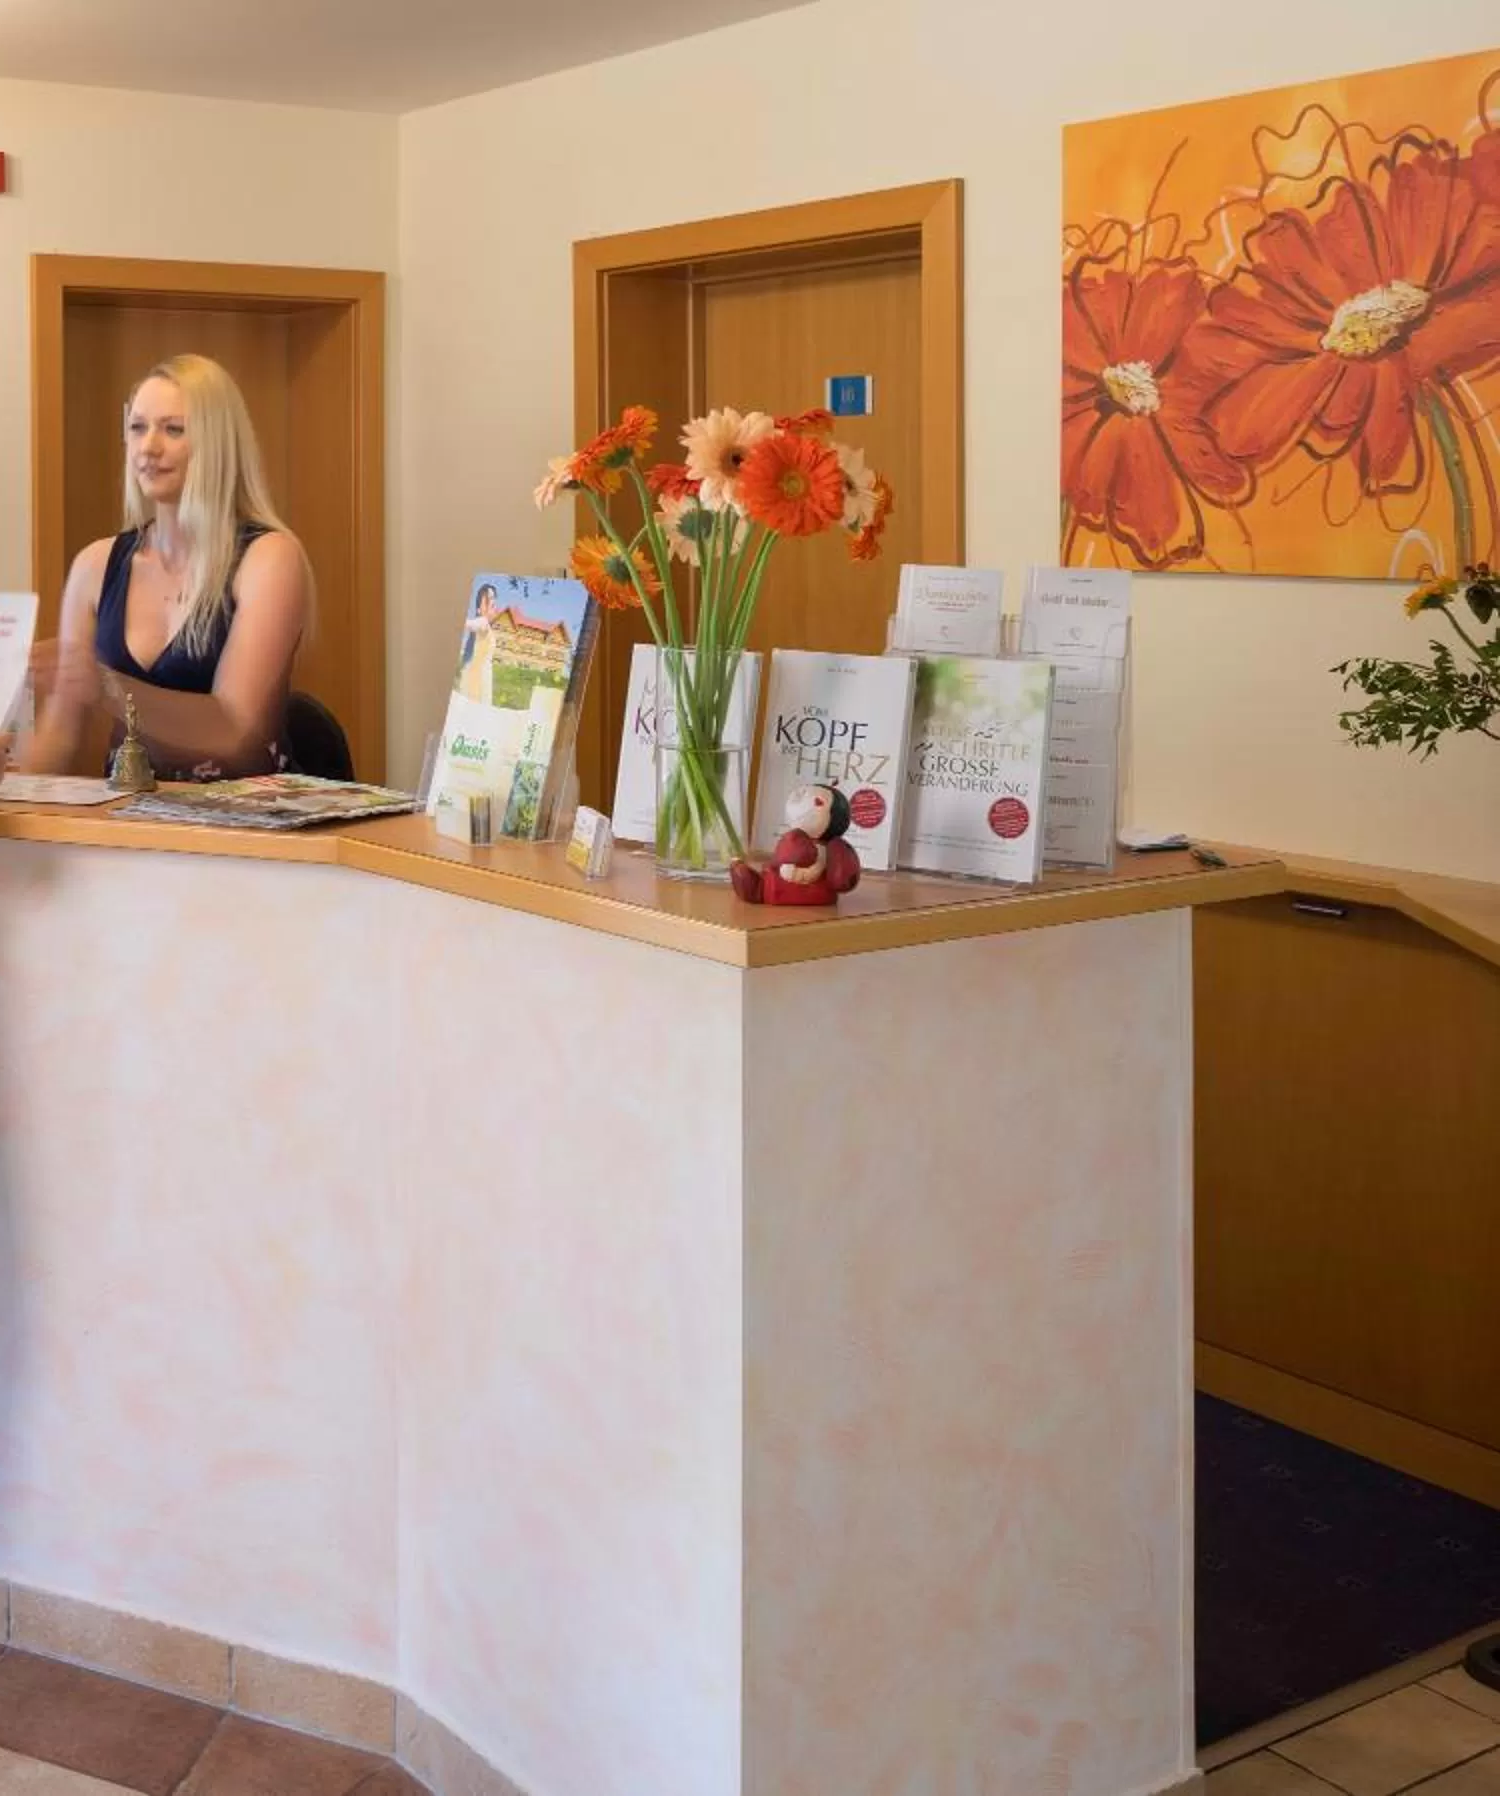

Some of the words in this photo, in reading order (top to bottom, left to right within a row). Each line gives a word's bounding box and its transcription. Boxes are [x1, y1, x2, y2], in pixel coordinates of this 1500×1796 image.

[776, 714, 869, 752] KOPF
[796, 744, 891, 785] HERZ
[919, 754, 1000, 778] GROSSE
